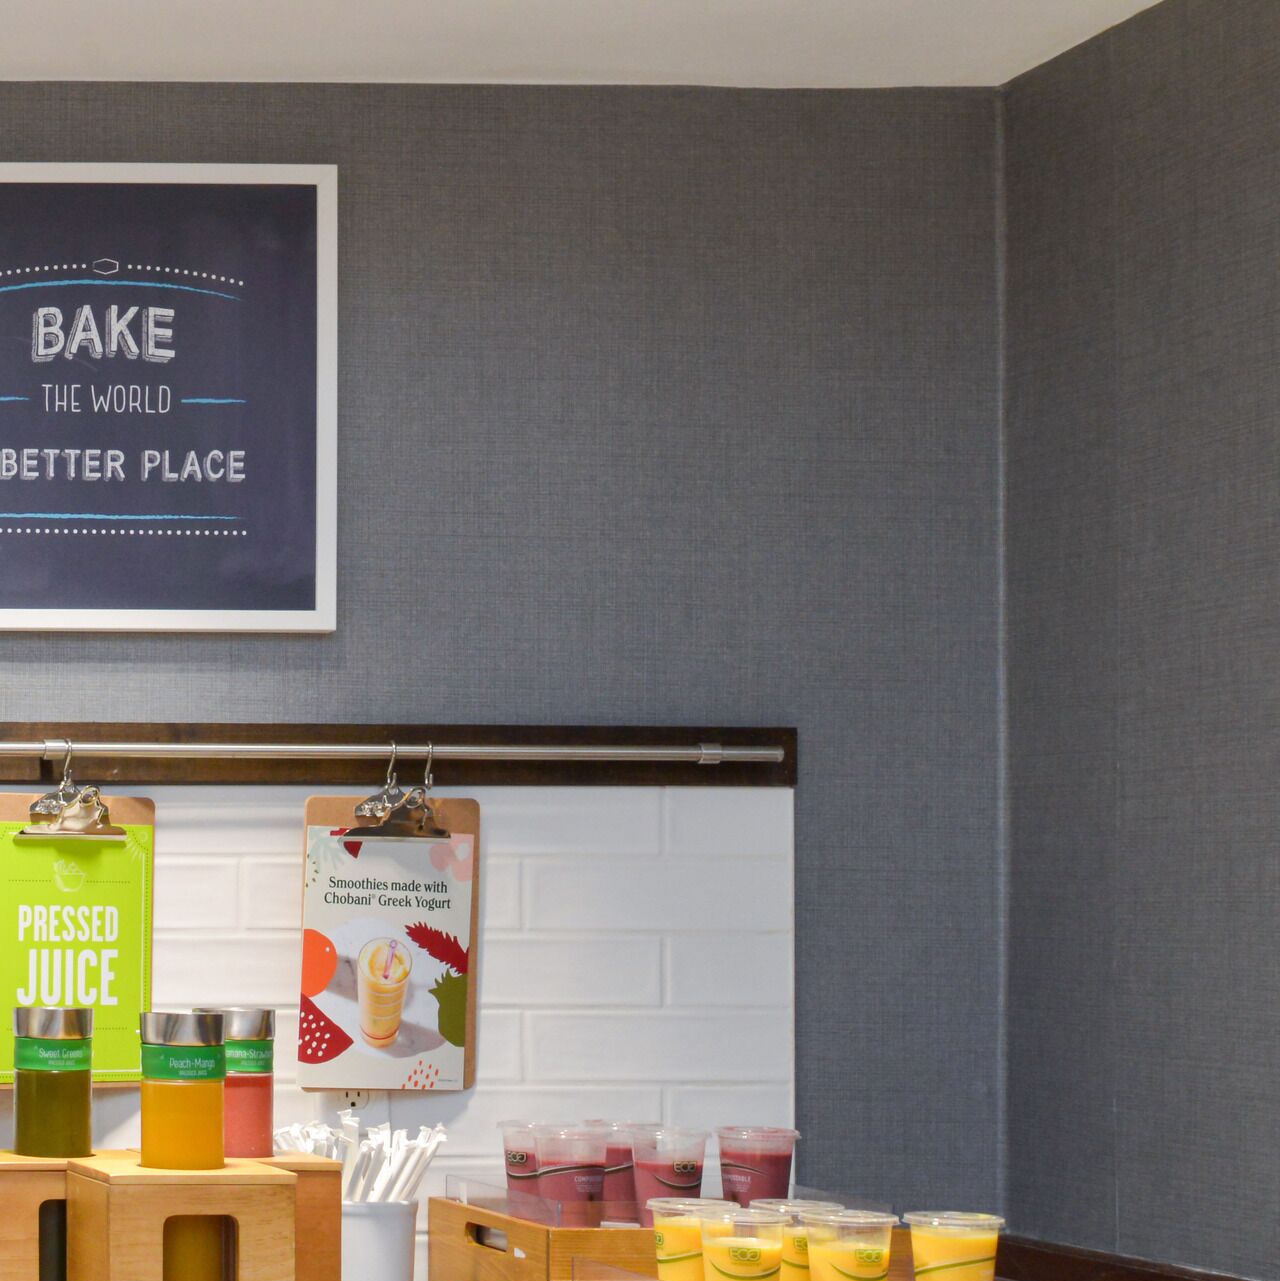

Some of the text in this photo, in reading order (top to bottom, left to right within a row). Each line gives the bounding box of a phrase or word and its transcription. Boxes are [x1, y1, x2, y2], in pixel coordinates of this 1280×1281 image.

[31, 304, 176, 363] BAKE
[41, 384, 172, 414] THE WORLD
[140, 449, 247, 482] PLACE
[328, 875, 448, 894] Smoothies made with
[378, 894, 412, 908] Greek
[414, 895, 451, 912] Yogurt
[17, 904, 119, 943] PRESSED
[16, 948, 119, 1006] JUICE
[38, 1047, 60, 1058] Sweet
[169, 1057, 216, 1070] Peach-Mango
